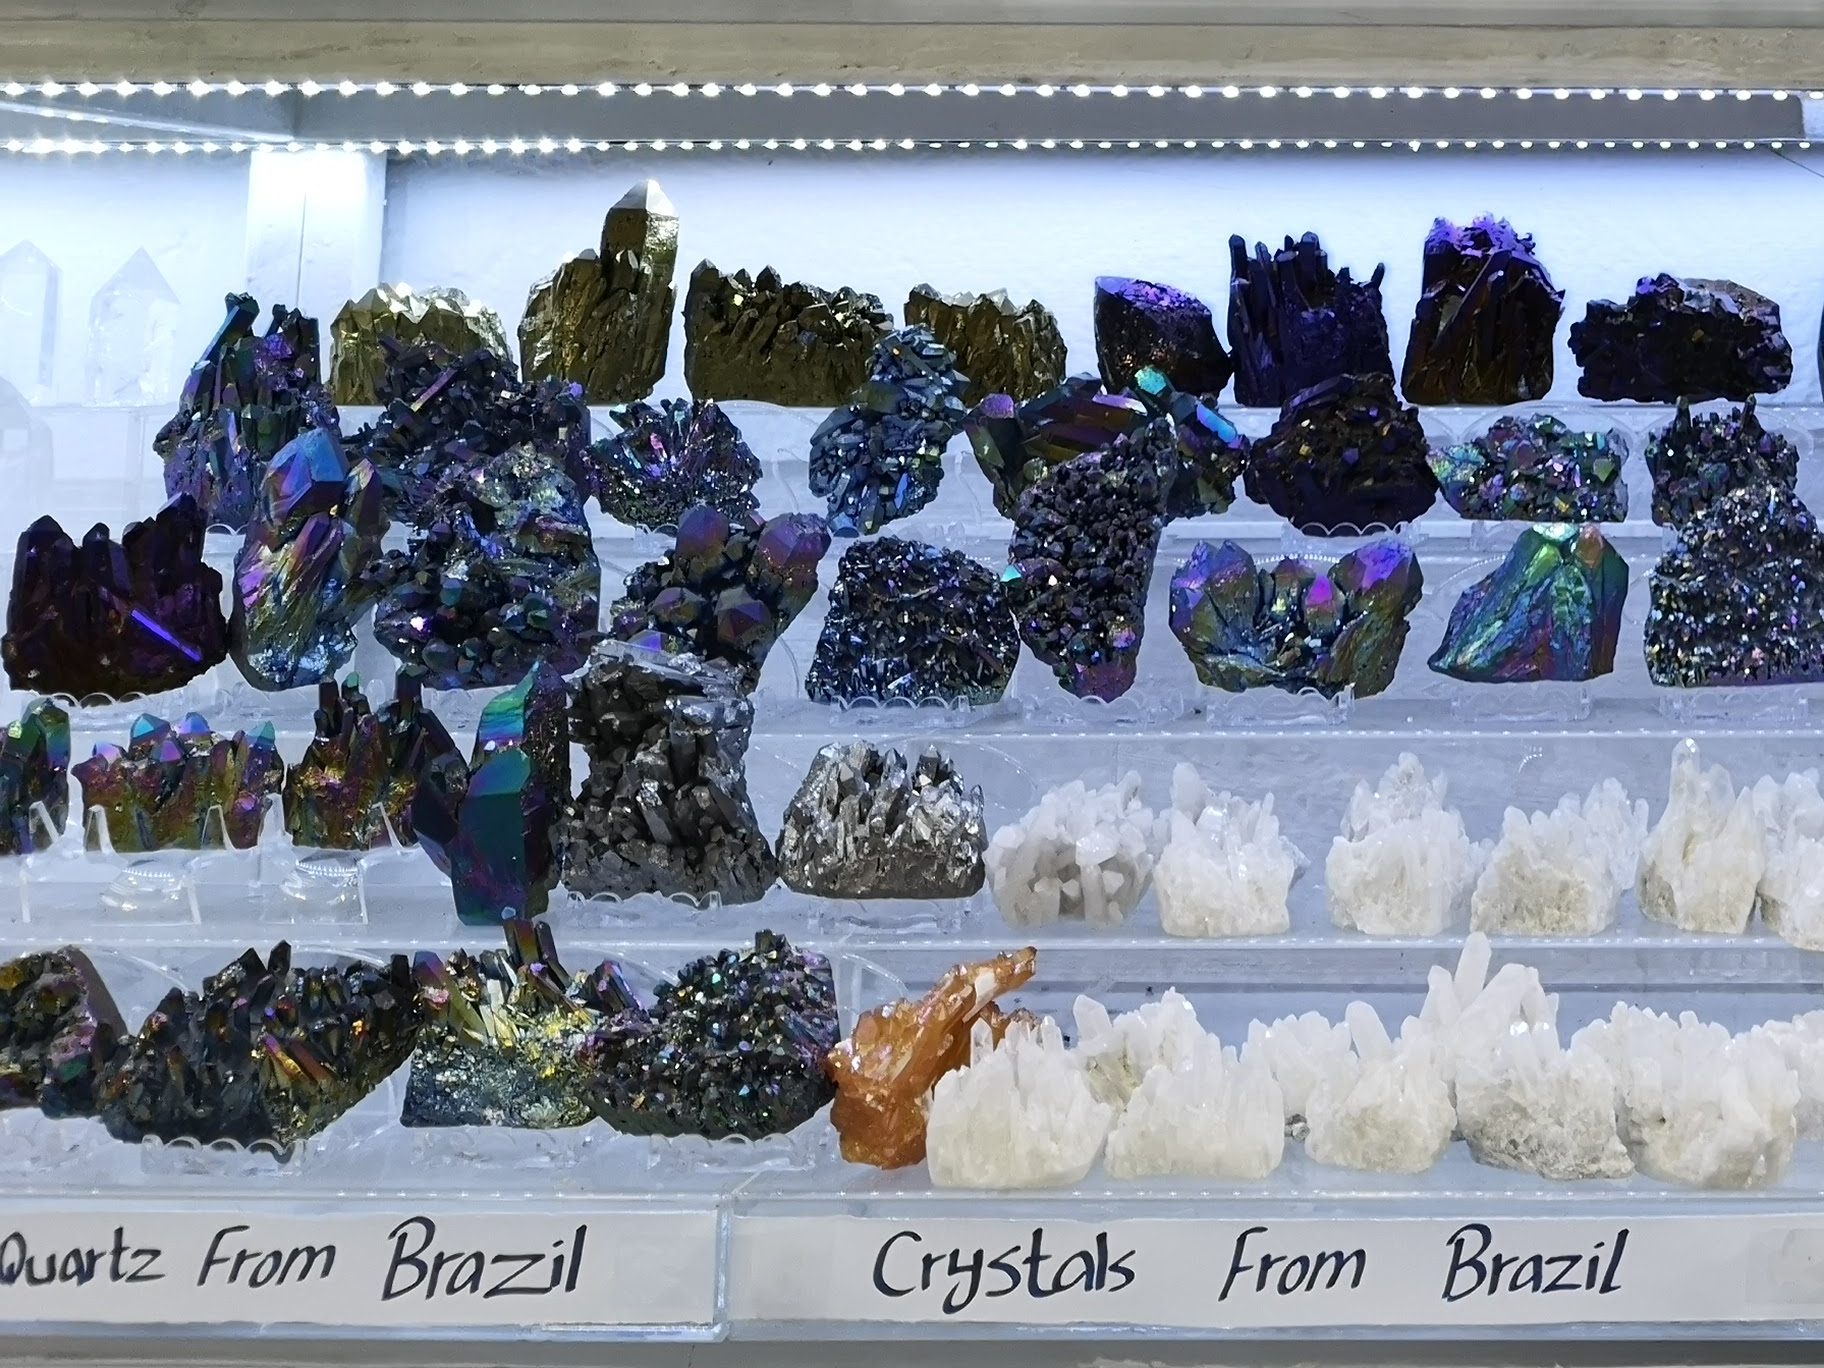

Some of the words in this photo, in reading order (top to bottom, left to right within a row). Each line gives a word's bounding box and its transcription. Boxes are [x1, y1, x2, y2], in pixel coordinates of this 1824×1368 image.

[0, 1226, 166, 1287] Quartz
[196, 1224, 337, 1289] From
[380, 1215, 588, 1302] Brazil
[872, 1227, 1136, 1315] Crystals
[1217, 1226, 1367, 1302] From
[1441, 1222, 1630, 1303] Brazil
